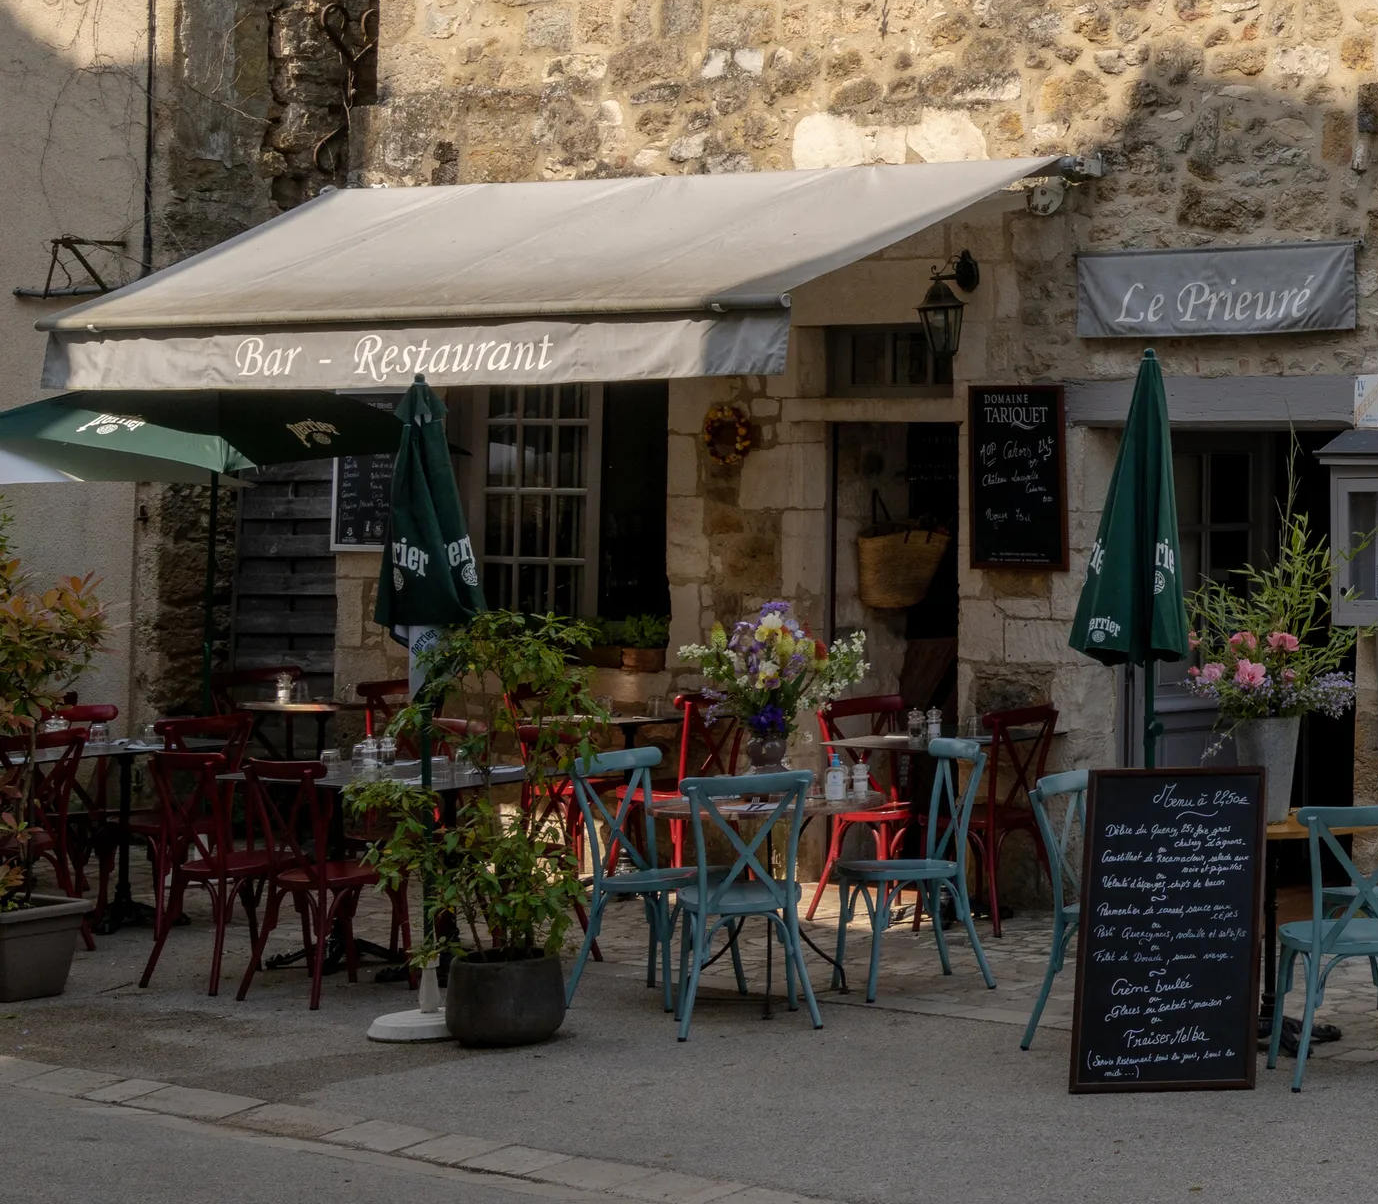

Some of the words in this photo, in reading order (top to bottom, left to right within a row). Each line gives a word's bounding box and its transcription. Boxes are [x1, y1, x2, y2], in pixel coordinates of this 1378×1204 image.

[1114, 282, 1165, 323] Le
[1177, 274, 1315, 322] Prieuré
[235, 337, 302, 376] Bar
[354, 334, 554, 382] Restaurant
[984, 394, 1029, 404] DOMAINE
[983, 406, 1048, 430] TARIQUET
[286, 418, 340, 448] perrier
[391, 537, 429, 577] rier
[1089, 616, 1121, 637] errier
[1152, 782, 1196, 808] Menu
[1134, 824, 1148, 835] du
[1143, 852, 1153, 863] de
[1207, 852, 1232, 863] salade
[1192, 878, 1202, 888] de
[1204, 878, 1226, 887] bacon
[1142, 905, 1154, 916] de
[1185, 903, 1212, 913] sauce
[1208, 928, 1216, 938] et
[1092, 948, 1115, 962] Filet
[1118, 950, 1129, 962] de
[1111, 978, 1150, 996] Crème
[1148, 996, 1163, 1004] ou
[1104, 1005, 1141, 1022] Glaces
[1150, 1016, 1163, 1024] ou
[1122, 1027, 1171, 1048] Fraises
[1170, 1025, 1211, 1045] Melba
[1203, 1050, 1221, 1059] tous
